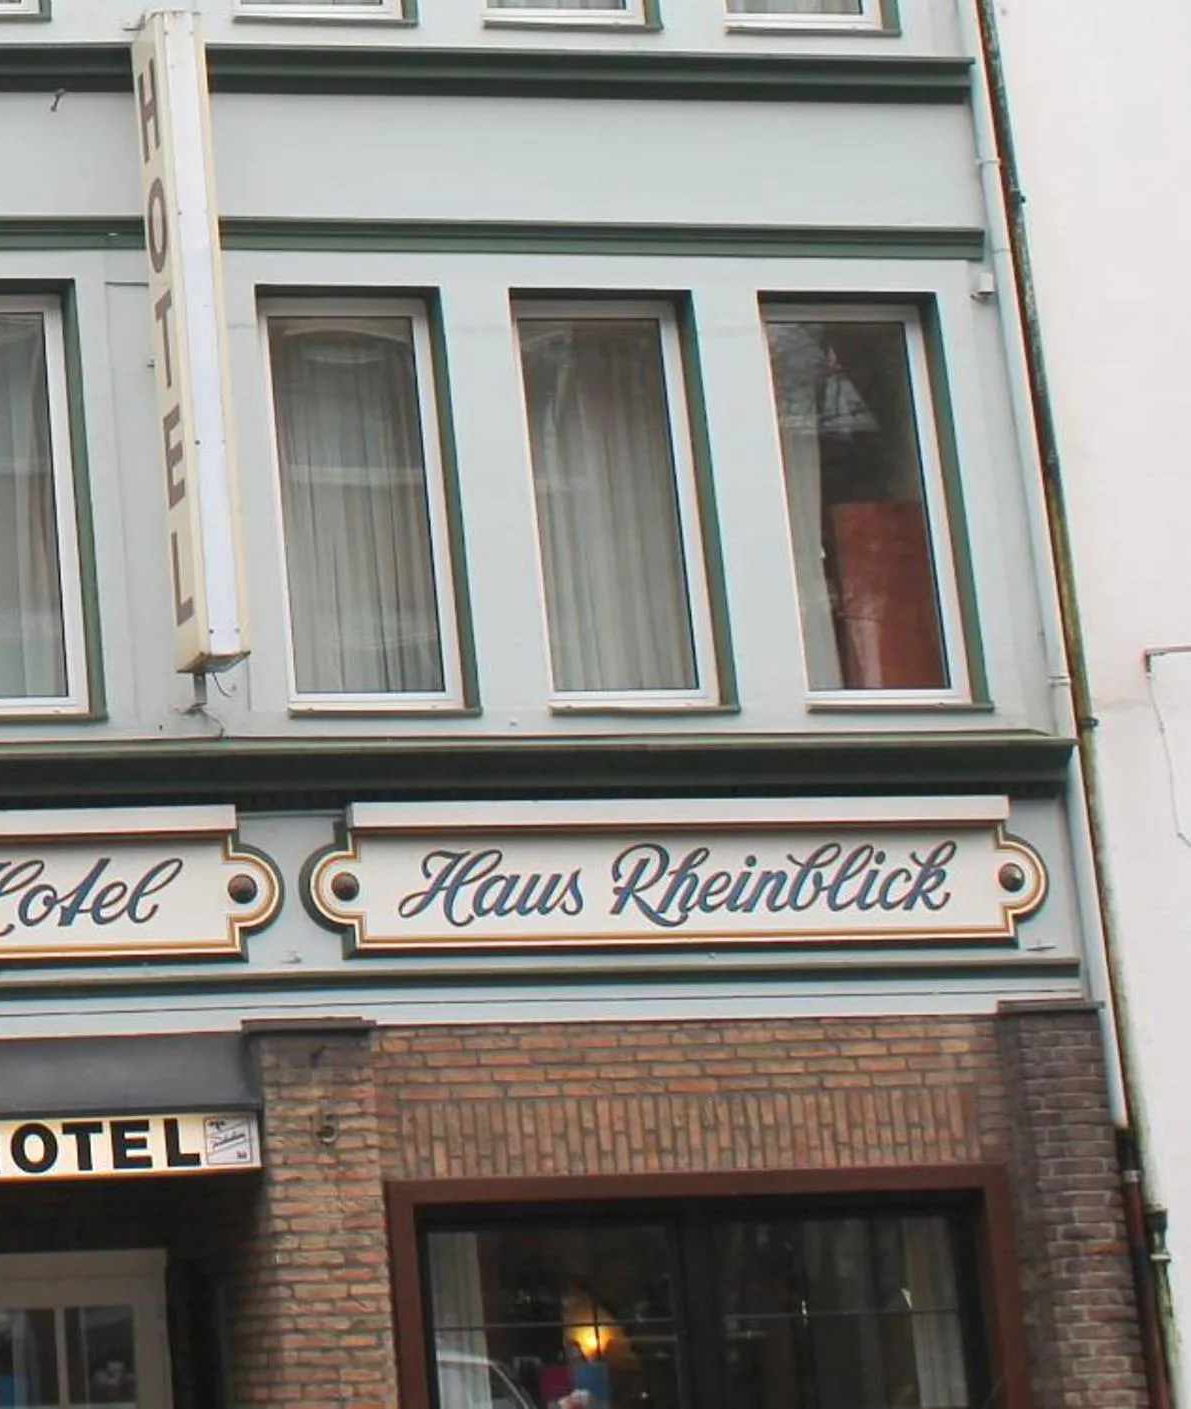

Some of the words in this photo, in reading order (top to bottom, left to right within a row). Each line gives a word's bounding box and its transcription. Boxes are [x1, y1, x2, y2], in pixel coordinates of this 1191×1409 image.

[137, 57, 196, 628] HOTEL
[397, 848, 584, 927] Haus
[609, 839, 958, 928] Rheinblick
